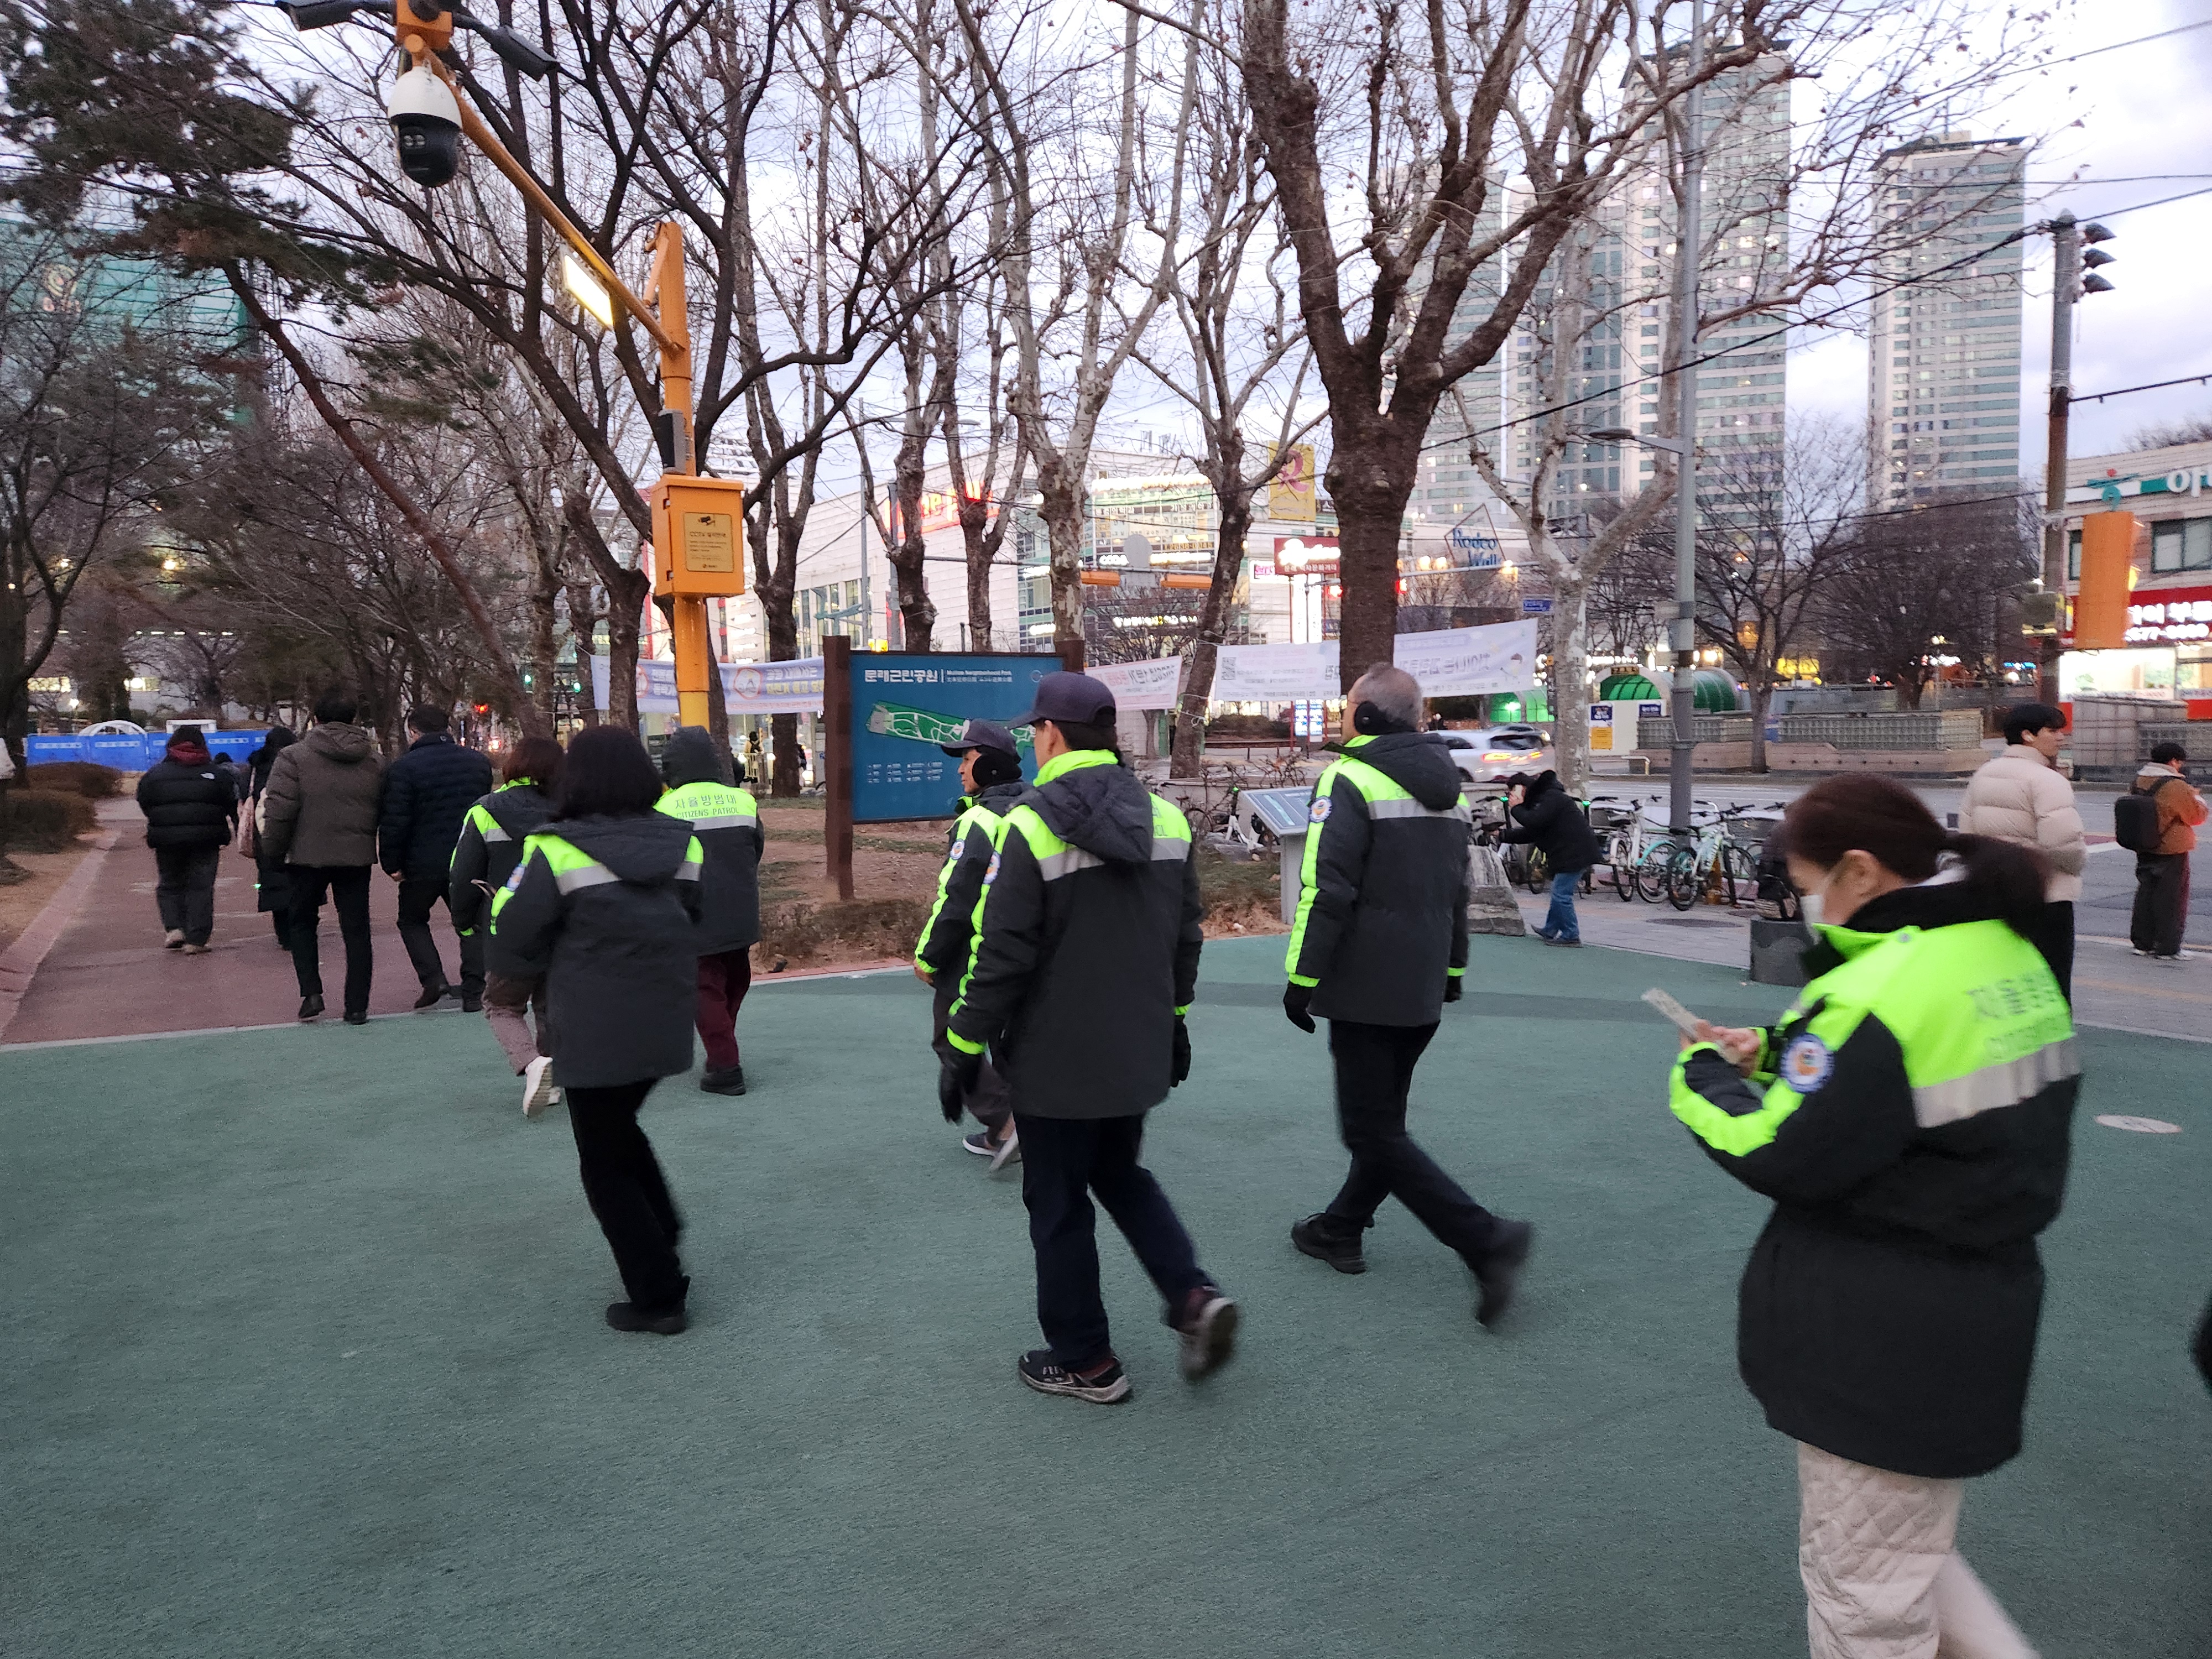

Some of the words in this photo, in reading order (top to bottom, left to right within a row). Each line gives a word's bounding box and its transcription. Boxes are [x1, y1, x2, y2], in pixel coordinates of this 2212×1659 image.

[865, 670, 938, 682] 문래근린공원
[675, 794, 737, 809] 자율방범대
[677, 809, 708, 818] CITIZENS
[712, 807, 739, 816] PATROL
